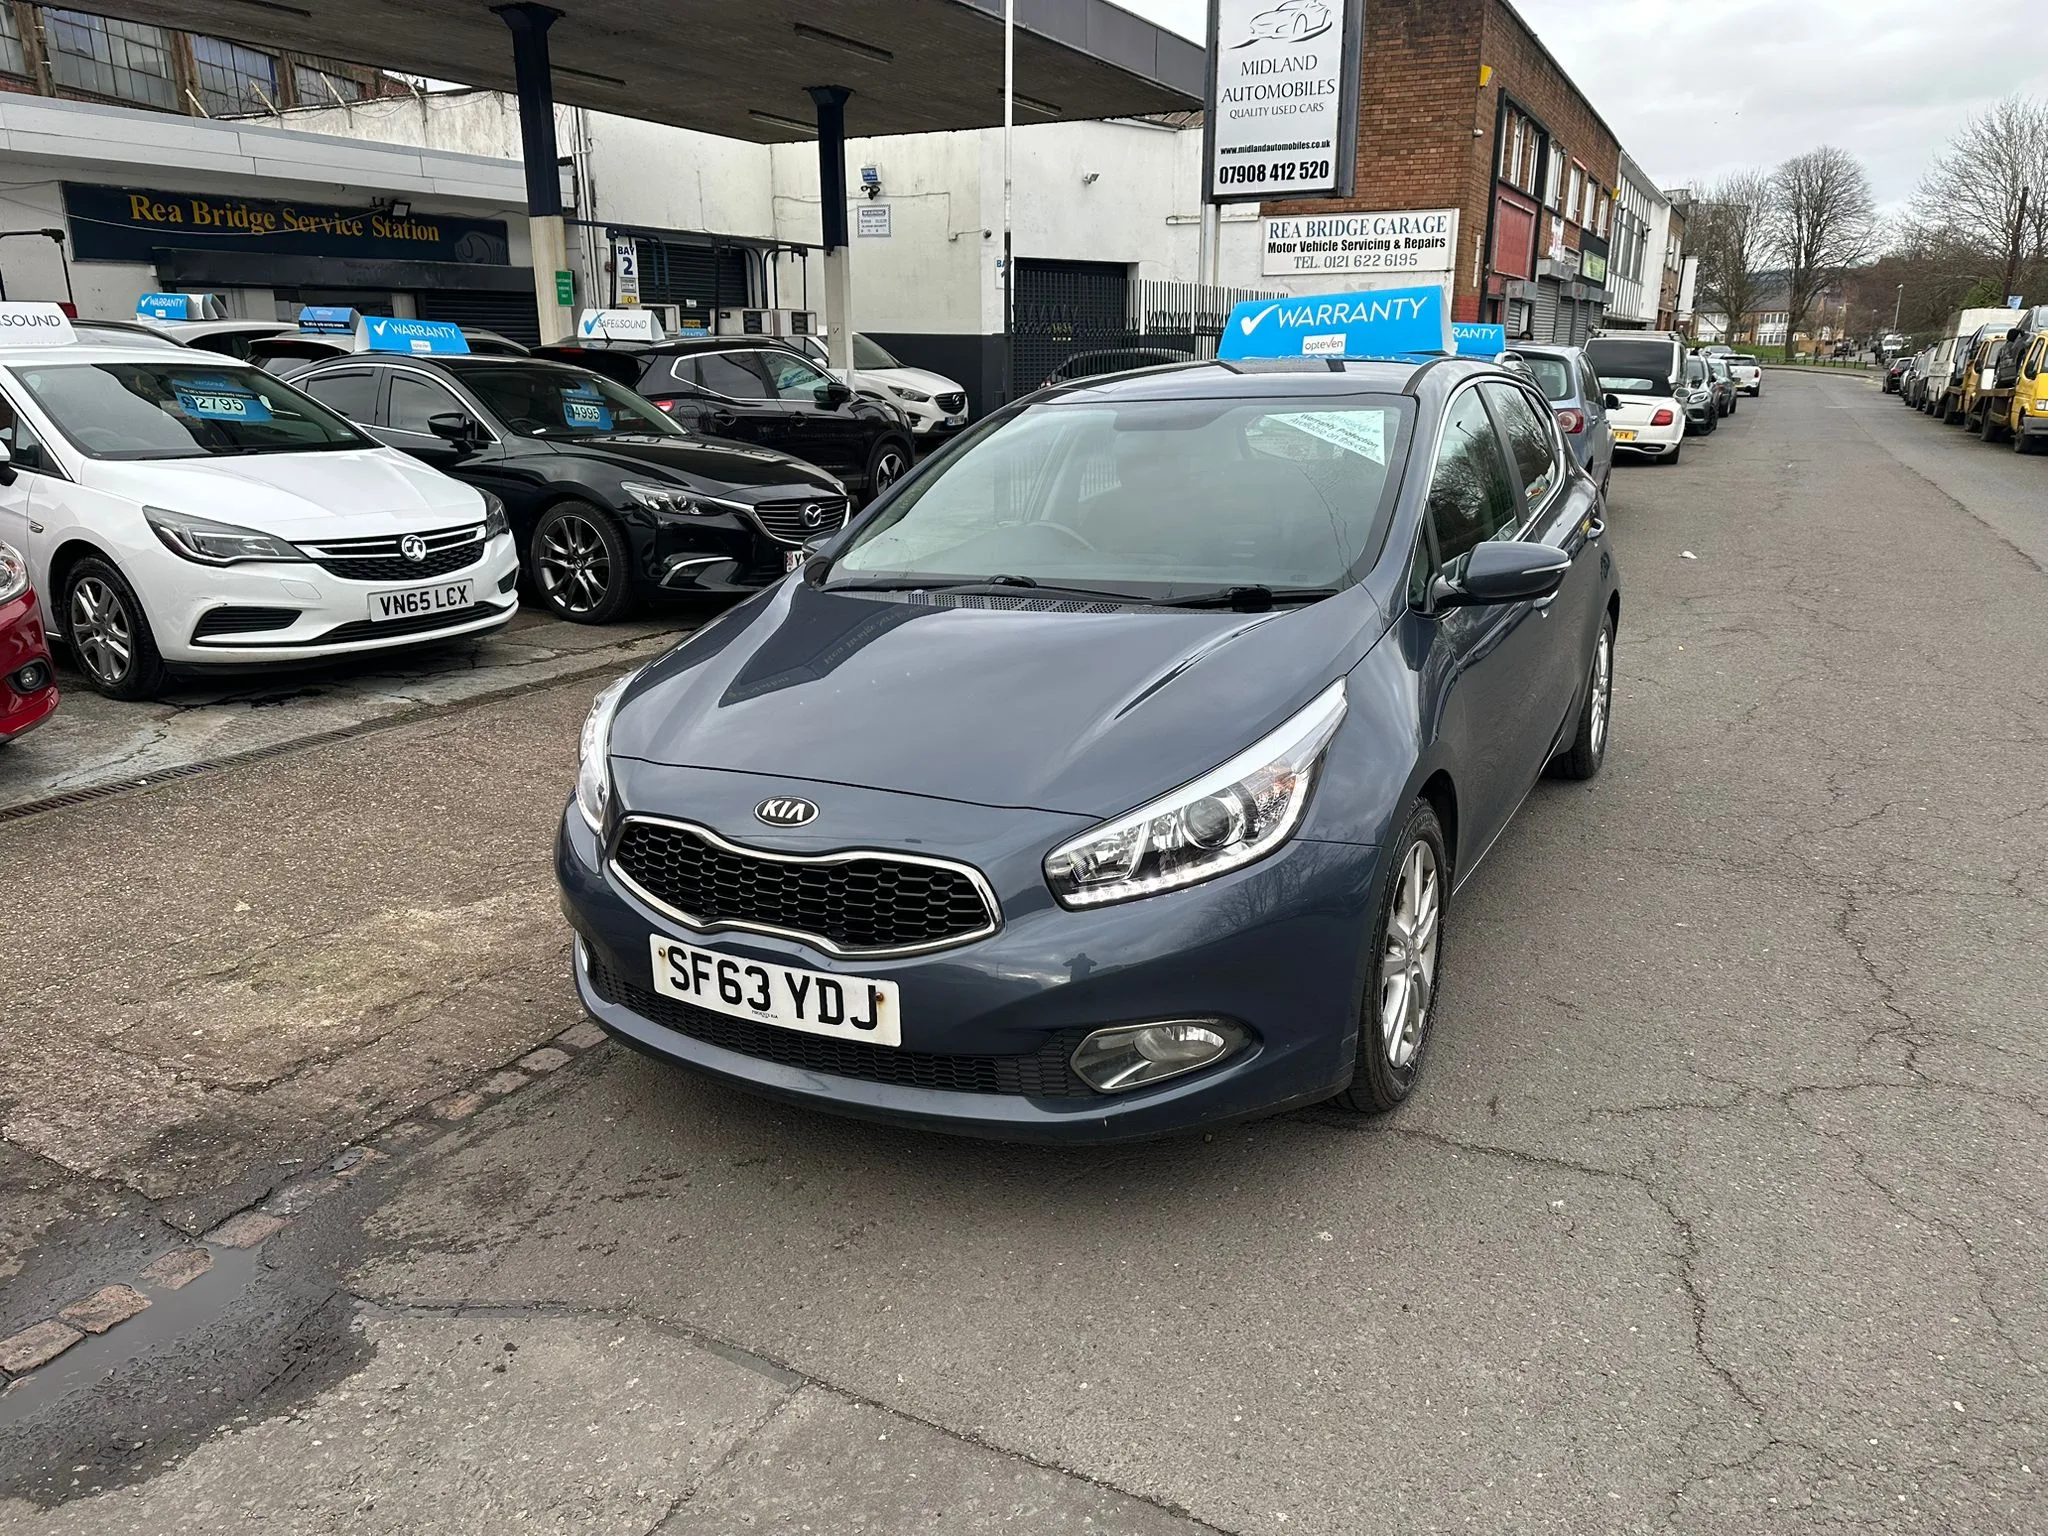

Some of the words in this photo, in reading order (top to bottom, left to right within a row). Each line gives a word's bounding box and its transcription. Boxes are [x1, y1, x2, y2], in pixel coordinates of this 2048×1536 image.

[1241, 54, 1318, 76] MIDLAND
[1221, 78, 1336, 103] AUTOMOBILES
[1229, 106, 1270, 119] QUALITY
[1271, 104, 1297, 115] USED
[1299, 102, 1325, 113] CARS
[1220, 139, 1331, 155] www.midlandautomobiles.co.uk
[1219, 164, 1266, 184] 07908
[1269, 162, 1296, 181] 412
[1299, 159, 1329, 180] 520
[128, 194, 183, 223] Rea
[191, 200, 276, 235] Bridge
[282, 208, 363, 236] Service
[371, 215, 440, 241] Station
[1269, 221, 1302, 239] REA
[1306, 218, 1370, 238] BRIDGE
[1373, 215, 1447, 236] GARAGE
[617, 246, 635, 255] BAY
[1268, 241, 1298, 254] Motor
[1299, 239, 1338, 253] Vehicle
[1341, 237, 1391, 251] Servicing
[1393, 239, 1401, 250] &
[1404, 236, 1446, 250] Repairs
[622, 256, 634, 276] 2
[1294, 255, 1321, 270] TEL.
[1324, 254, 1350, 269] 0121
[1353, 253, 1381, 268] 622
[1384, 252, 1418, 267] 6195
[150, 298, 183, 308] WARRANTY
[1278, 297, 1427, 328] WARRANTY
[389, 322, 456, 340] WARRANTY
[597, 319, 647, 330] SAFE&SOUND
[1452, 326, 1498, 340] RANTY
[1304, 336, 1344, 351] opteven
[380, 591, 431, 616] VN65
[435, 585, 468, 609] LCX
[761, 799, 806, 821] KIA
[667, 945, 772, 1012] SF63
[784, 972, 878, 1031] YDJ
